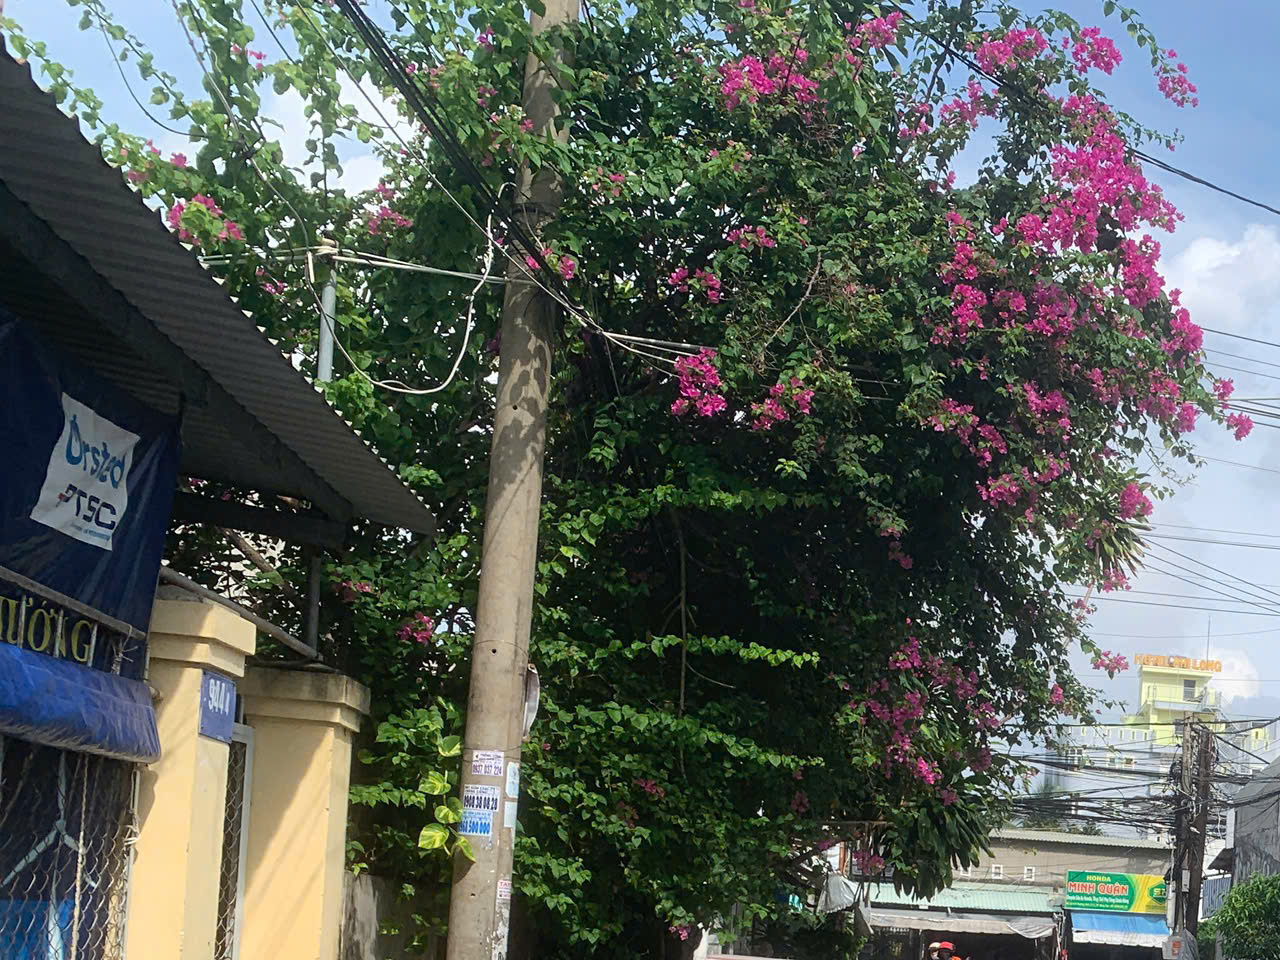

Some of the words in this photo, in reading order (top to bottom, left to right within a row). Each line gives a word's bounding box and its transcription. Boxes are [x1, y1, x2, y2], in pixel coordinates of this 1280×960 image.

[1086, 874, 1112, 882] HONDA
[1067, 881, 1096, 894] MINH
[1097, 882, 1129, 896] QUÂN
